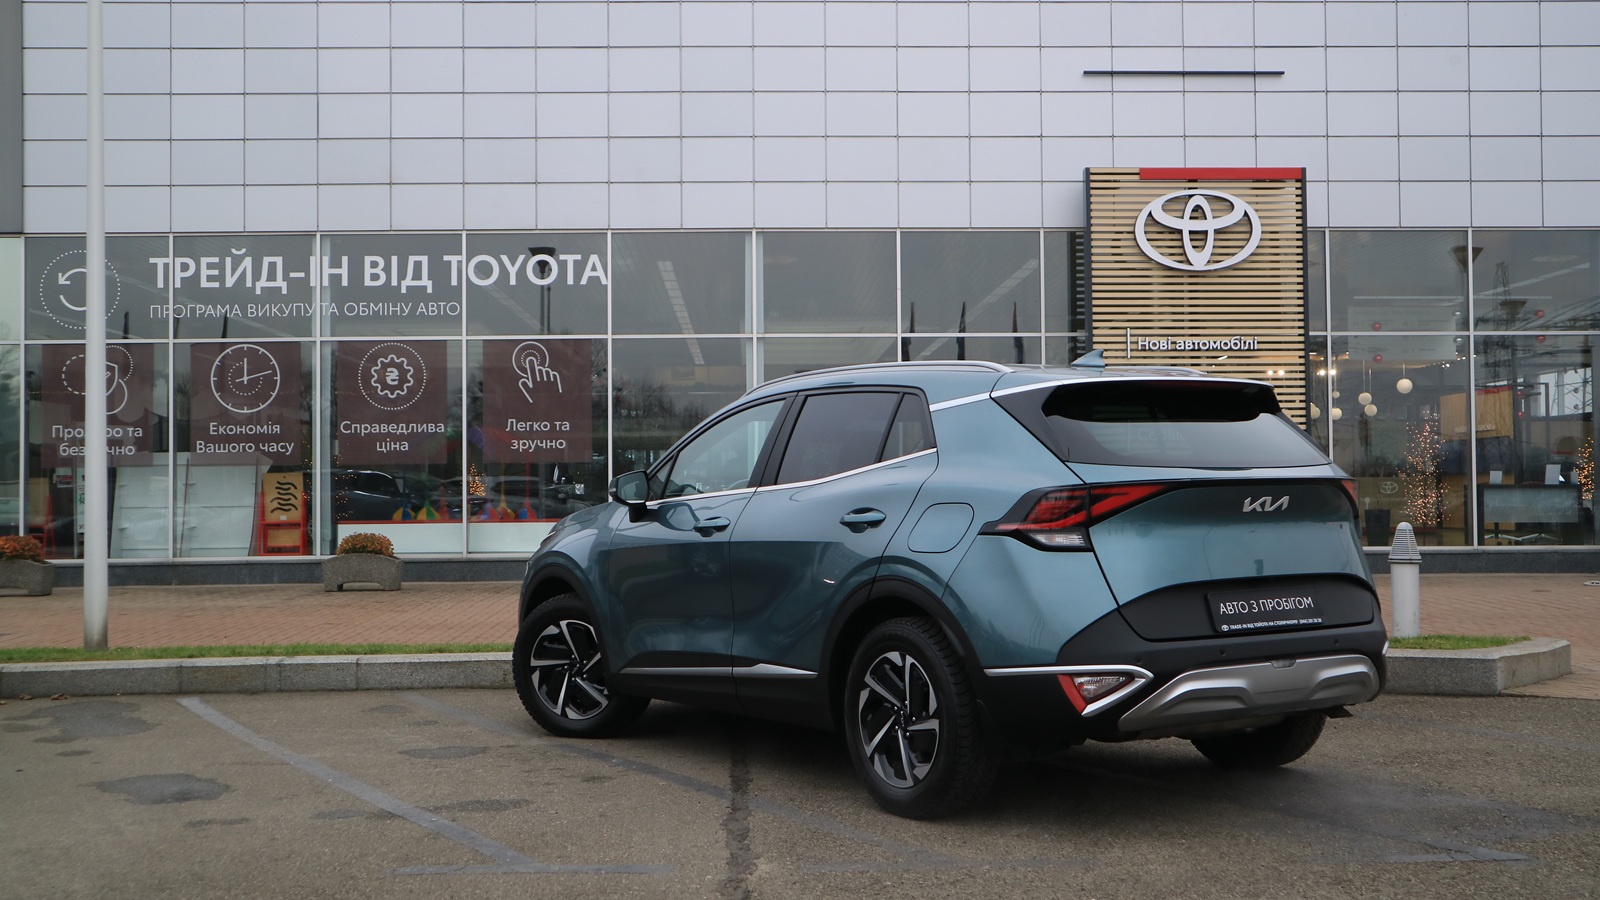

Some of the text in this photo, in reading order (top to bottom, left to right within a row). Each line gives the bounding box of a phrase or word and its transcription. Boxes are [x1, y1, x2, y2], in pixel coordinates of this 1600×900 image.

[149, 248, 608, 294] ТРЕЙД-ІН ВІД TOYOTA
[150, 304, 242, 318] ПРОГРАМА
[247, 303, 315, 317] ВИКУПУ
[344, 302, 412, 316] ОБМІНУ
[416, 302, 460, 315] АВТО
[1138, 336, 1258, 350] Нові автомобілі
[126, 426, 143, 437] та
[209, 421, 281, 435] Економія
[340, 421, 445, 436] Справедлива
[505, 418, 570, 432] Легко та
[196, 441, 294, 454] Вашого часу
[376, 438, 409, 452] ціна
[510, 437, 566, 452] зручно
[1242, 495, 1290, 513] KIA
[1220, 601, 1249, 615] АВТО
[1259, 596, 1314, 611] ПРОБІГОМ
